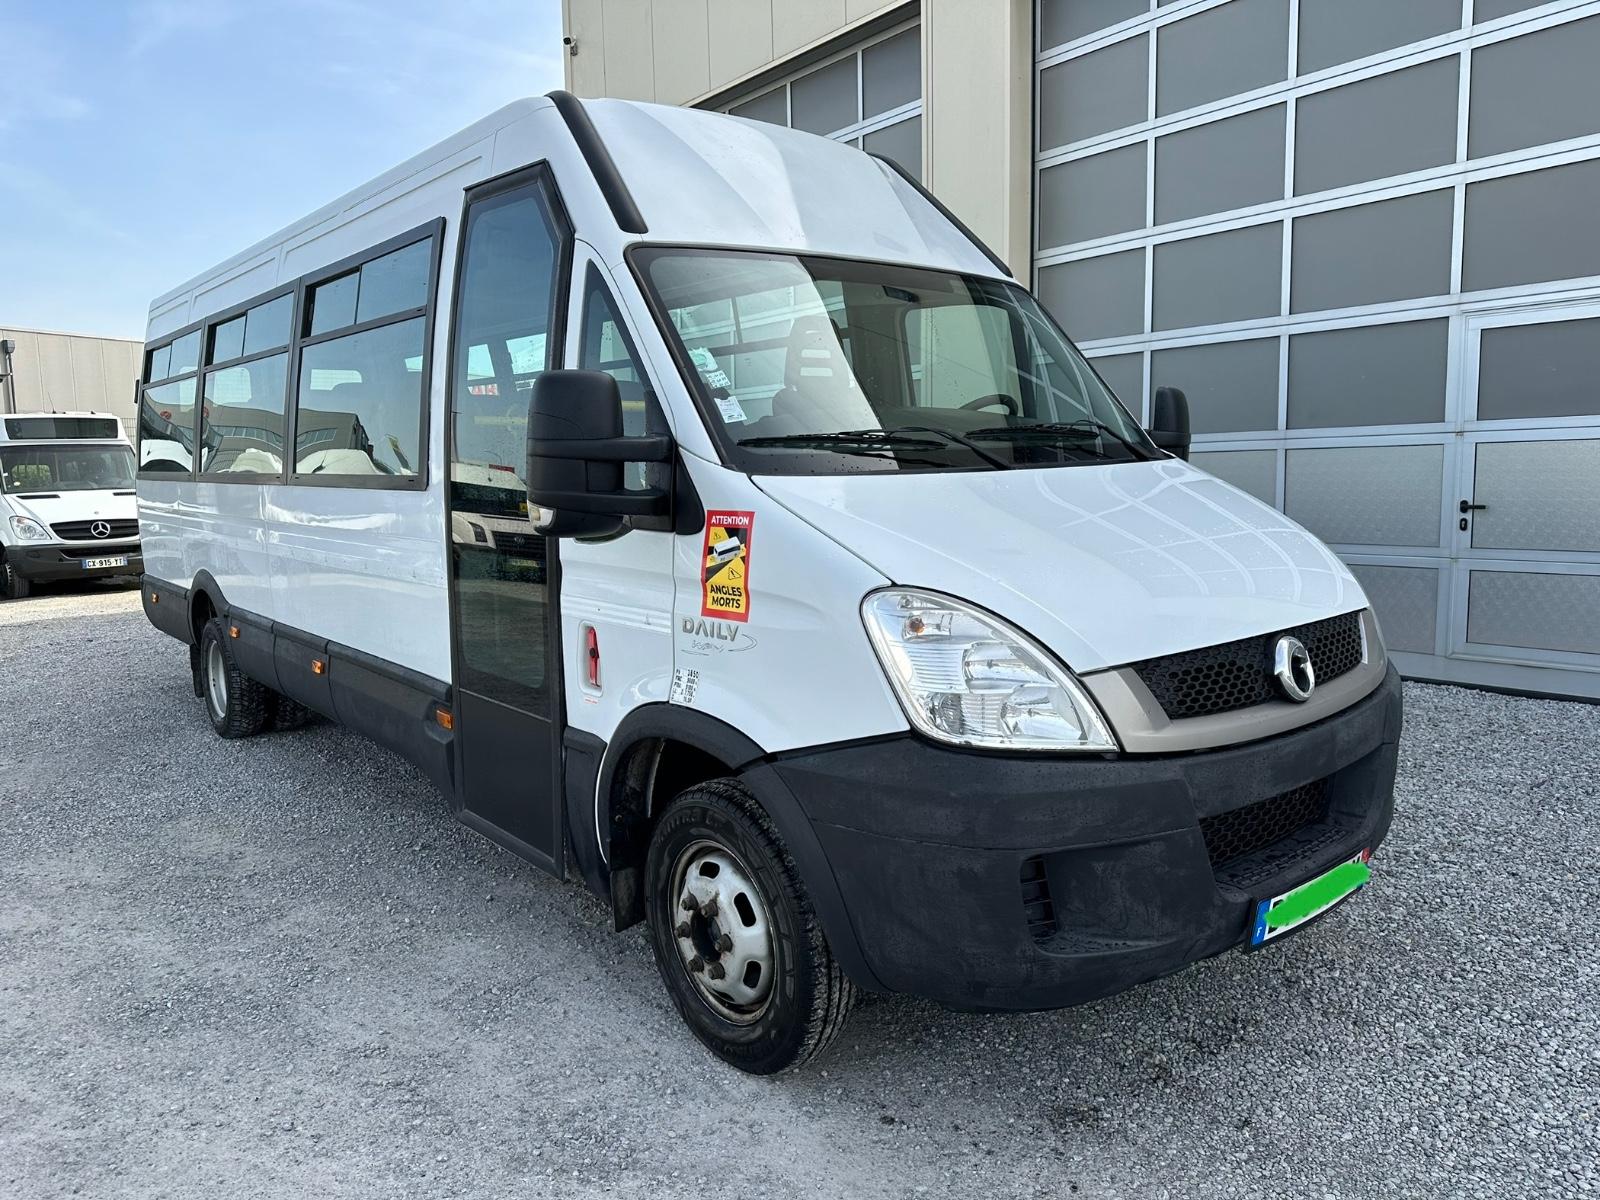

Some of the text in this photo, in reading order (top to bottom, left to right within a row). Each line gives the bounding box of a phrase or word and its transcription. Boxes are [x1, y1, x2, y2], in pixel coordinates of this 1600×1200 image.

[711, 515, 749, 525] ATTENTION
[710, 584, 742, 597] ANGLES
[711, 596, 741, 609] MORTS
[682, 617, 739, 641] DAILY
